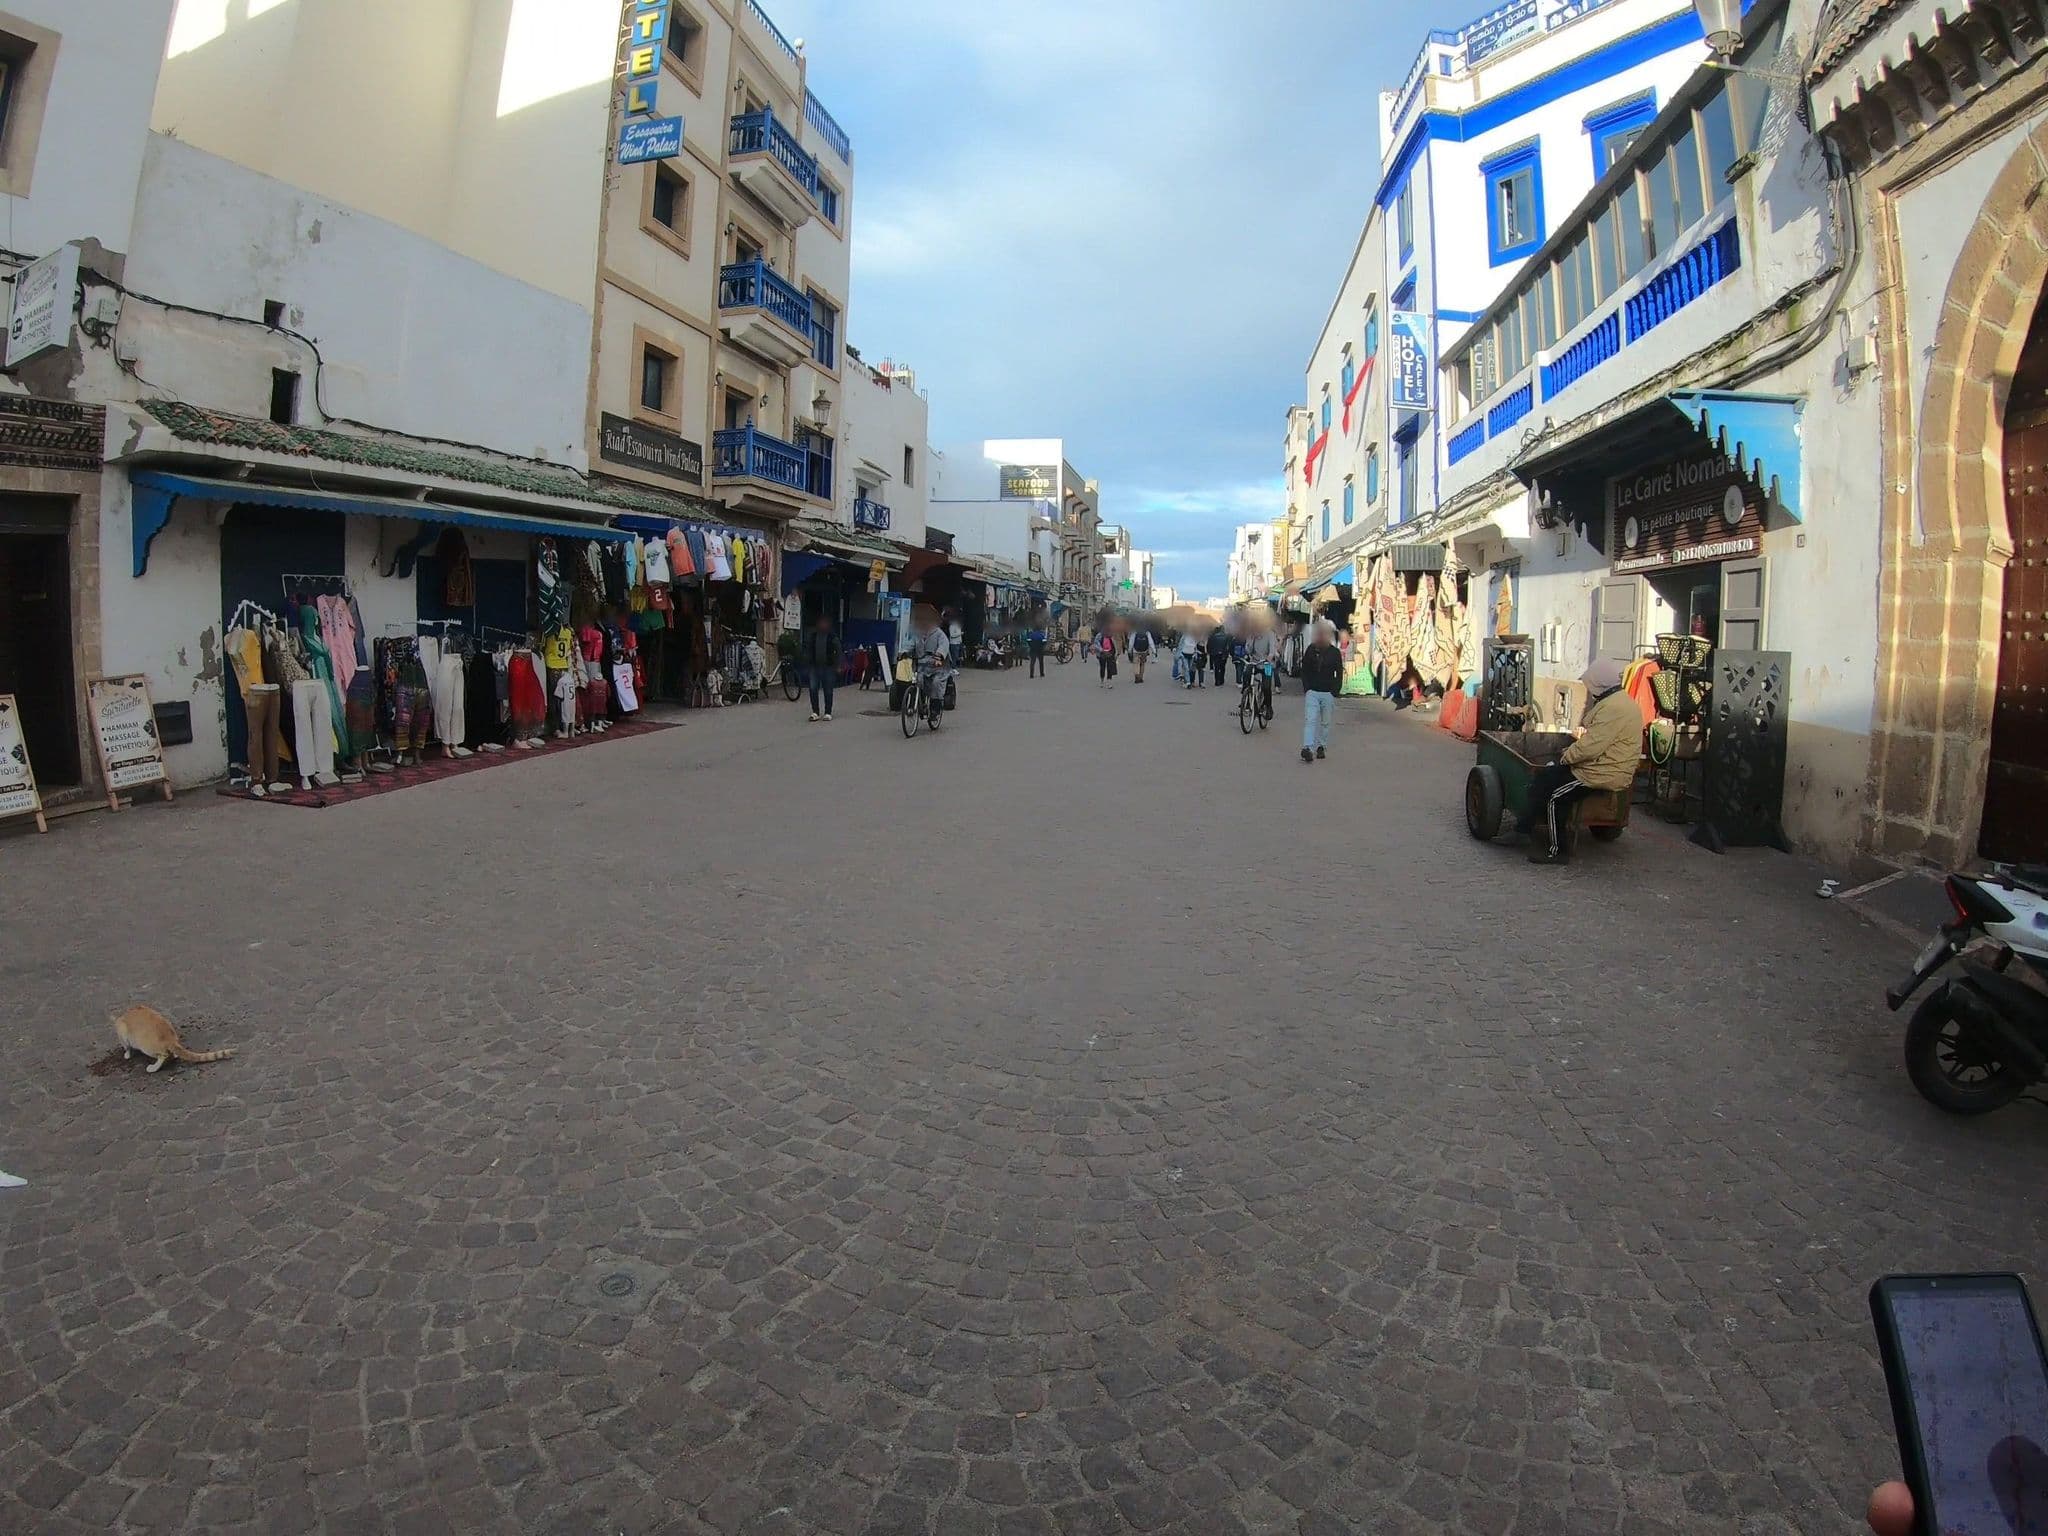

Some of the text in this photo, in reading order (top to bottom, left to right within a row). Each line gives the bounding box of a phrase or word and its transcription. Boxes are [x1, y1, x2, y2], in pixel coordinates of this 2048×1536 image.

[628, 0, 661, 112] TEL
[626, 123, 674, 141] Essaouira
[620, 136, 678, 160] Wind Palace
[1401, 336, 1415, 401] HOTEL
[606, 429, 700, 475] Riad Essaouira Wind Palace
[1008, 479, 1050, 488] SEAFOOD
[1617, 455, 1731, 508] Le Carré Noma
[1641, 504, 1714, 533] la petite boutique
[654, 588, 663, 602] 2
[558, 641, 566, 658] 9
[622, 674, 632, 690] 2
[568, 685, 575, 700] 5
[106, 721, 139, 733] HAMMAM
[108, 732, 141, 743] MASSAGE
[110, 740, 150, 753] ESTHETIQUE
